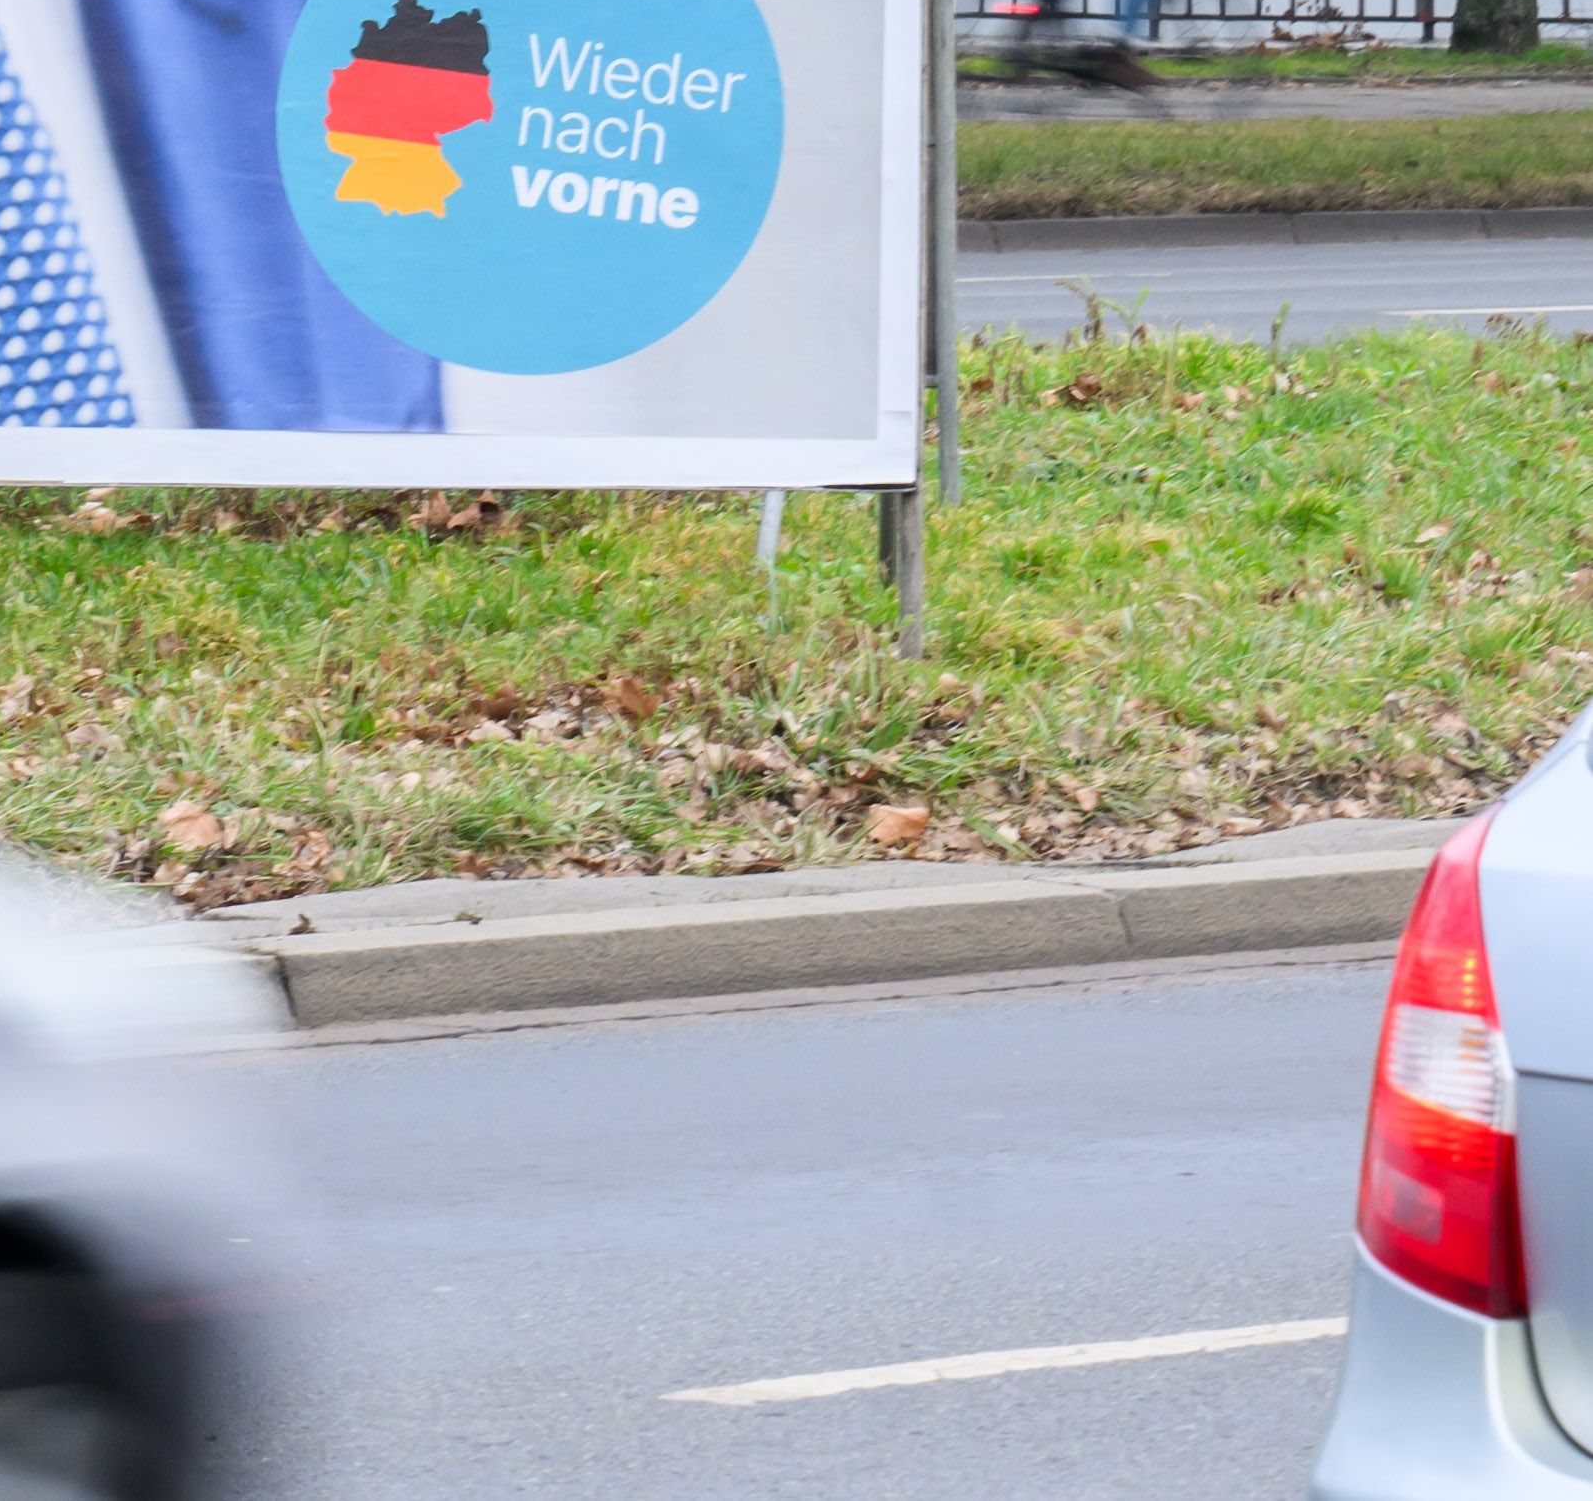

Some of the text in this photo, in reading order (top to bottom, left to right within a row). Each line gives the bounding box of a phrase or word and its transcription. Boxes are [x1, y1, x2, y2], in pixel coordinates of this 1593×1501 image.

[528, 32, 747, 113] Wieder
[517, 105, 667, 165] nach
[511, 164, 701, 230] vorne
